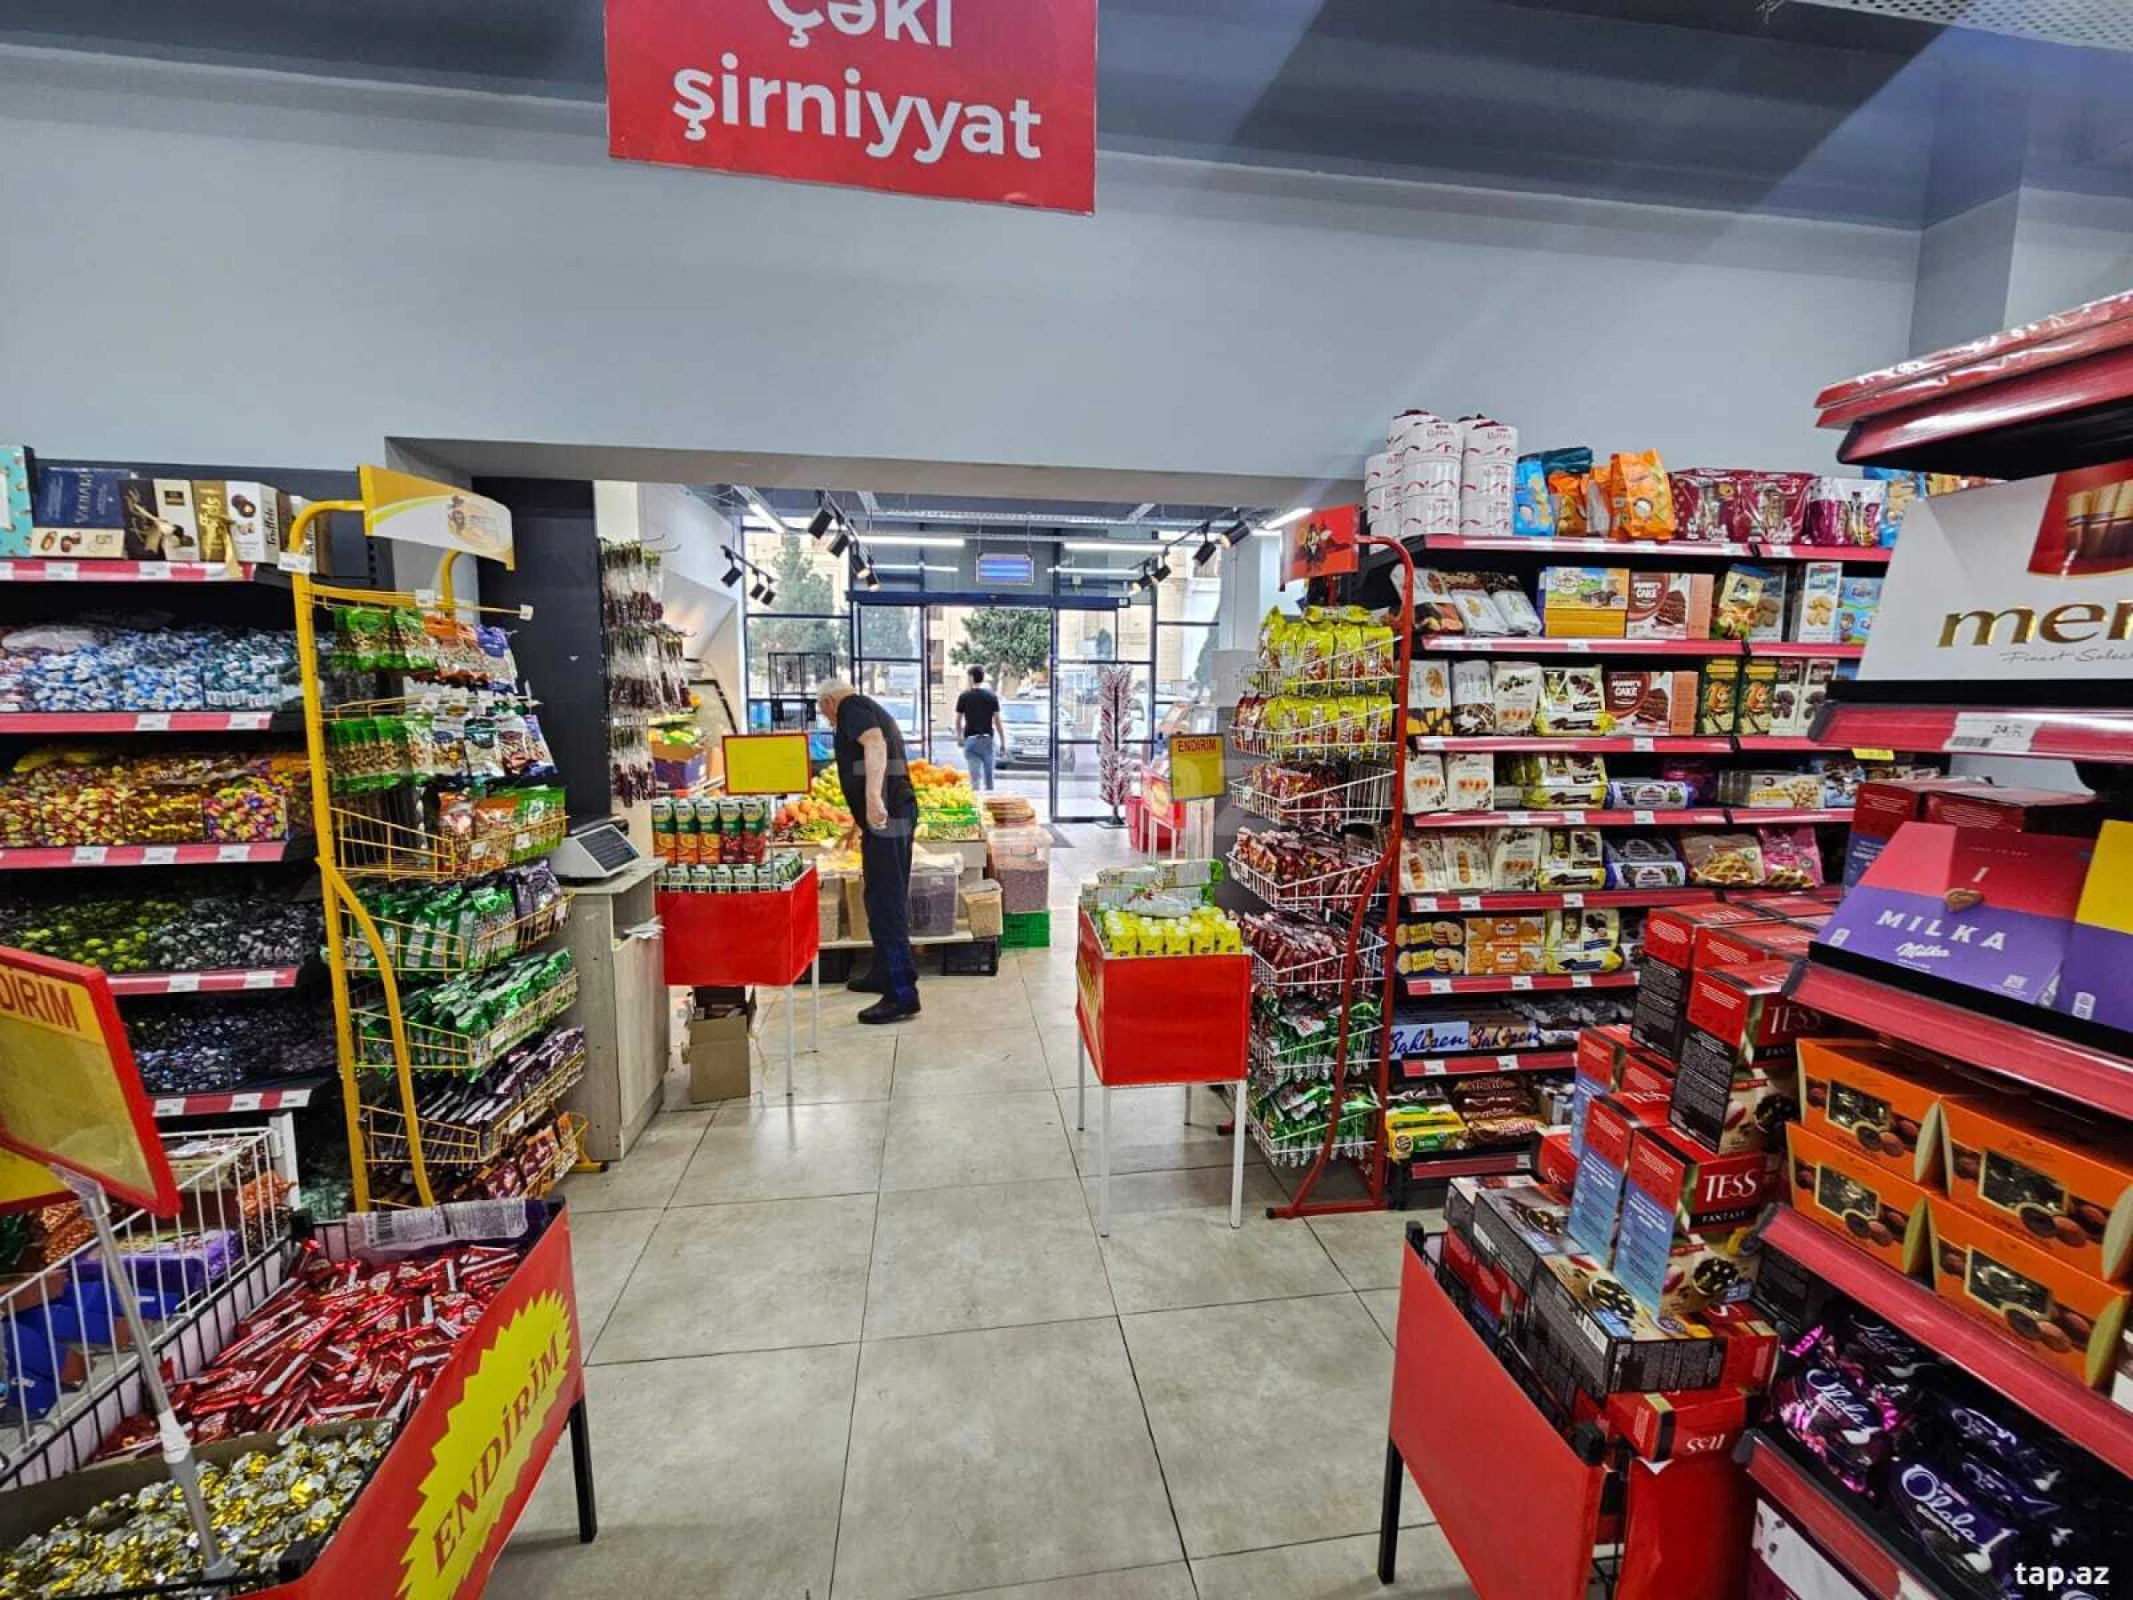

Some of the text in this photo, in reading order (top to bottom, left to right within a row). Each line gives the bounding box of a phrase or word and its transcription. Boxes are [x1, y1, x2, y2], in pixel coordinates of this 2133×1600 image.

[672, 52, 1042, 164] şirniyyat
[1876, 909, 2007, 951] MILKA
[1895, 942, 1950, 959] Milka
[1769, 1006, 1821, 1034] TESS
[1703, 1168, 1757, 1203] TESS
[433, 1334, 560, 1579] ENDİRİM
